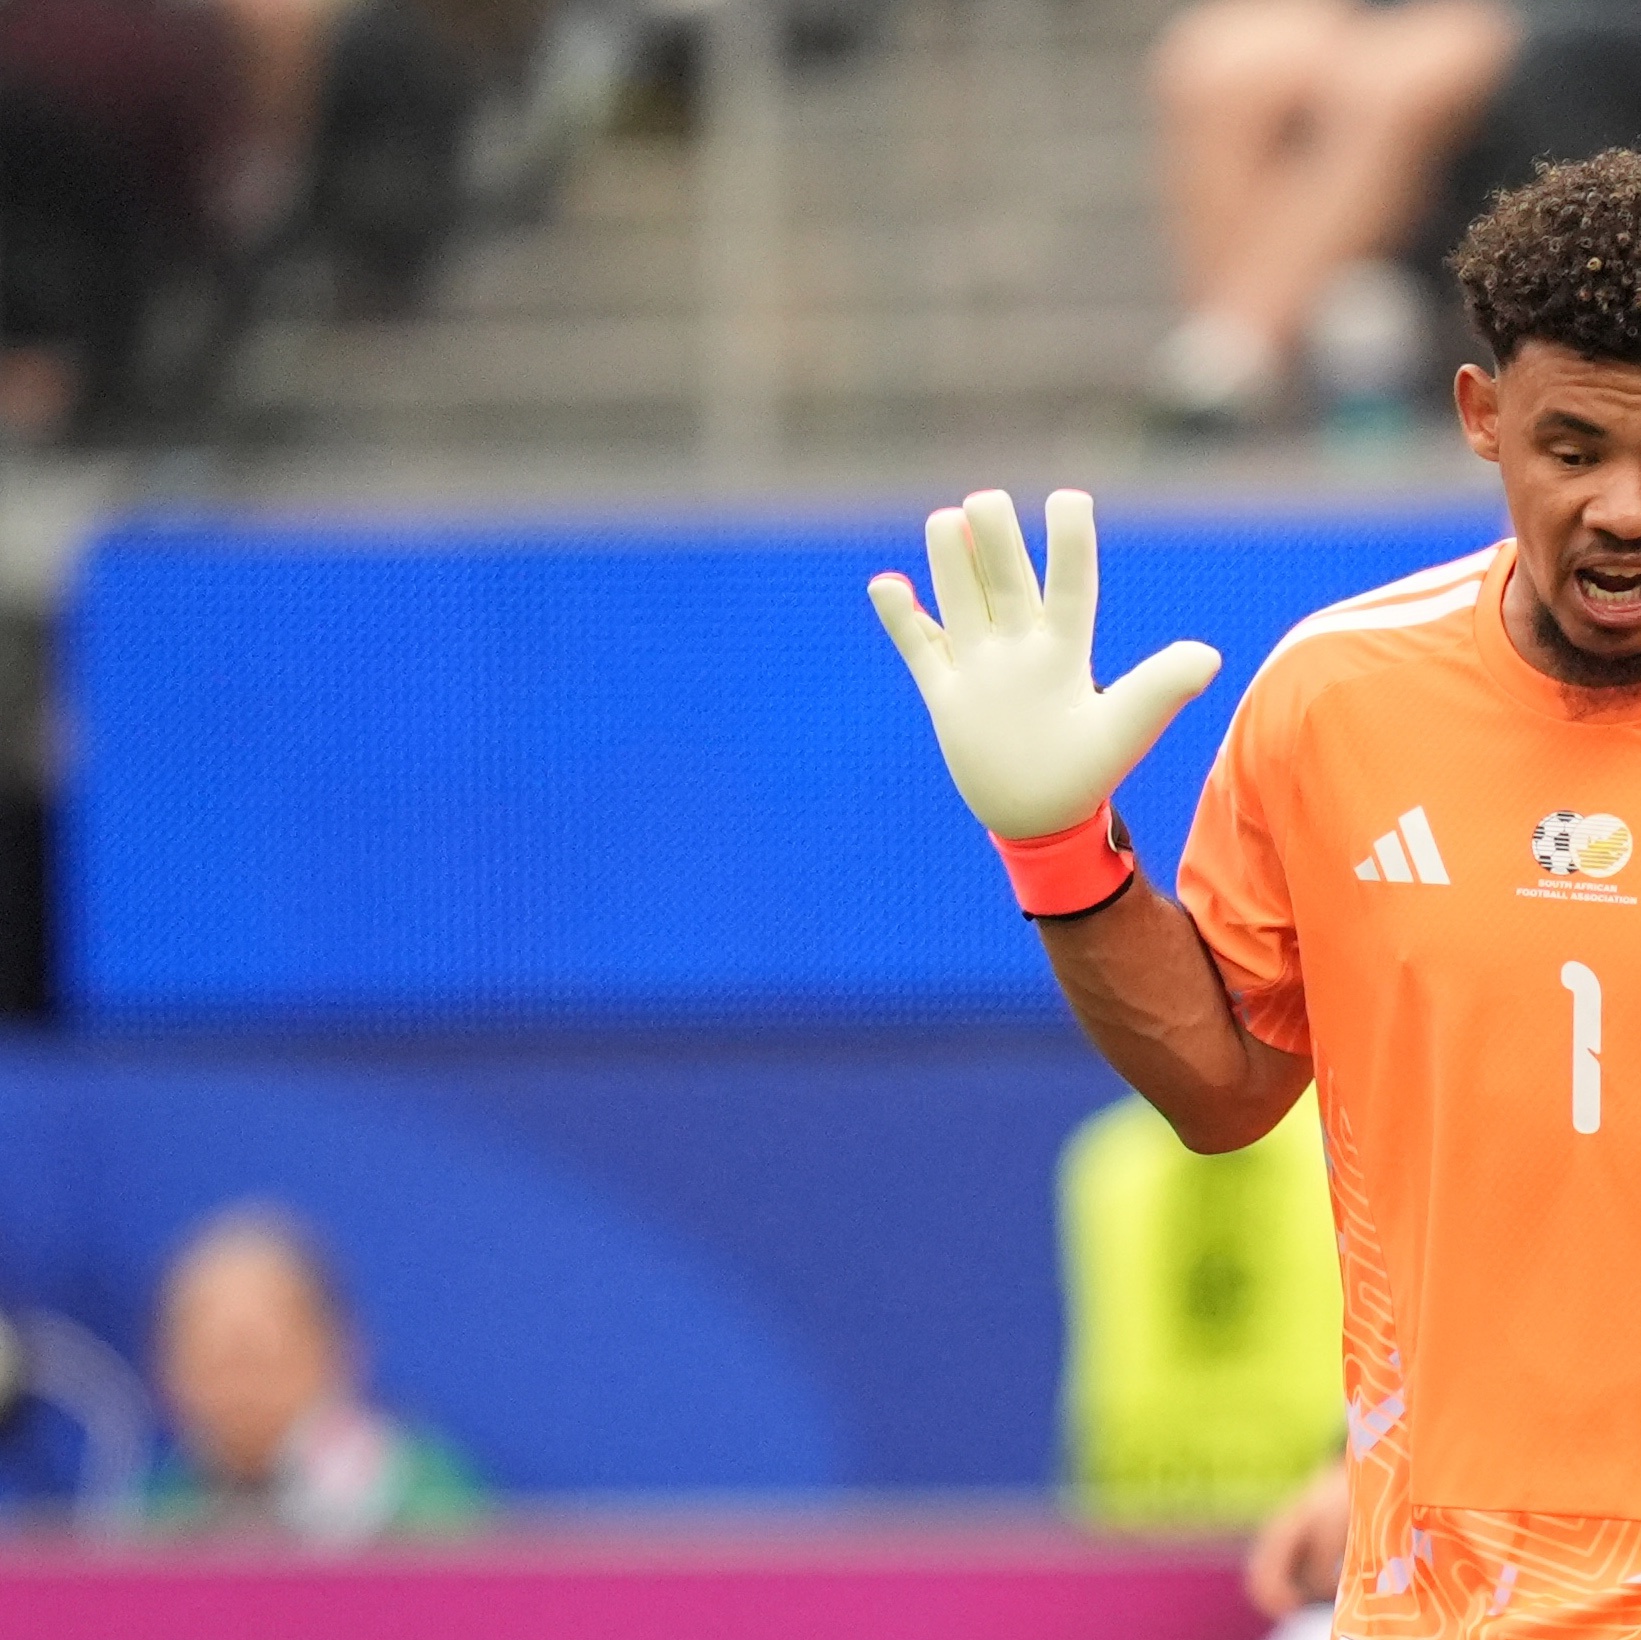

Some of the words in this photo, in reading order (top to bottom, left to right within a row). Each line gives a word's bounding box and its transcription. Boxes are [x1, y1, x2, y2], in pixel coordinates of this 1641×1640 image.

[1538, 879, 1573, 889] SOUTH
[1574, 882, 1618, 892] AFRICAN
[1516, 888, 1568, 900] FOOTBALL
[1570, 892, 1638, 904] ASSOCIATION
[1560, 960, 1602, 1134] 1
